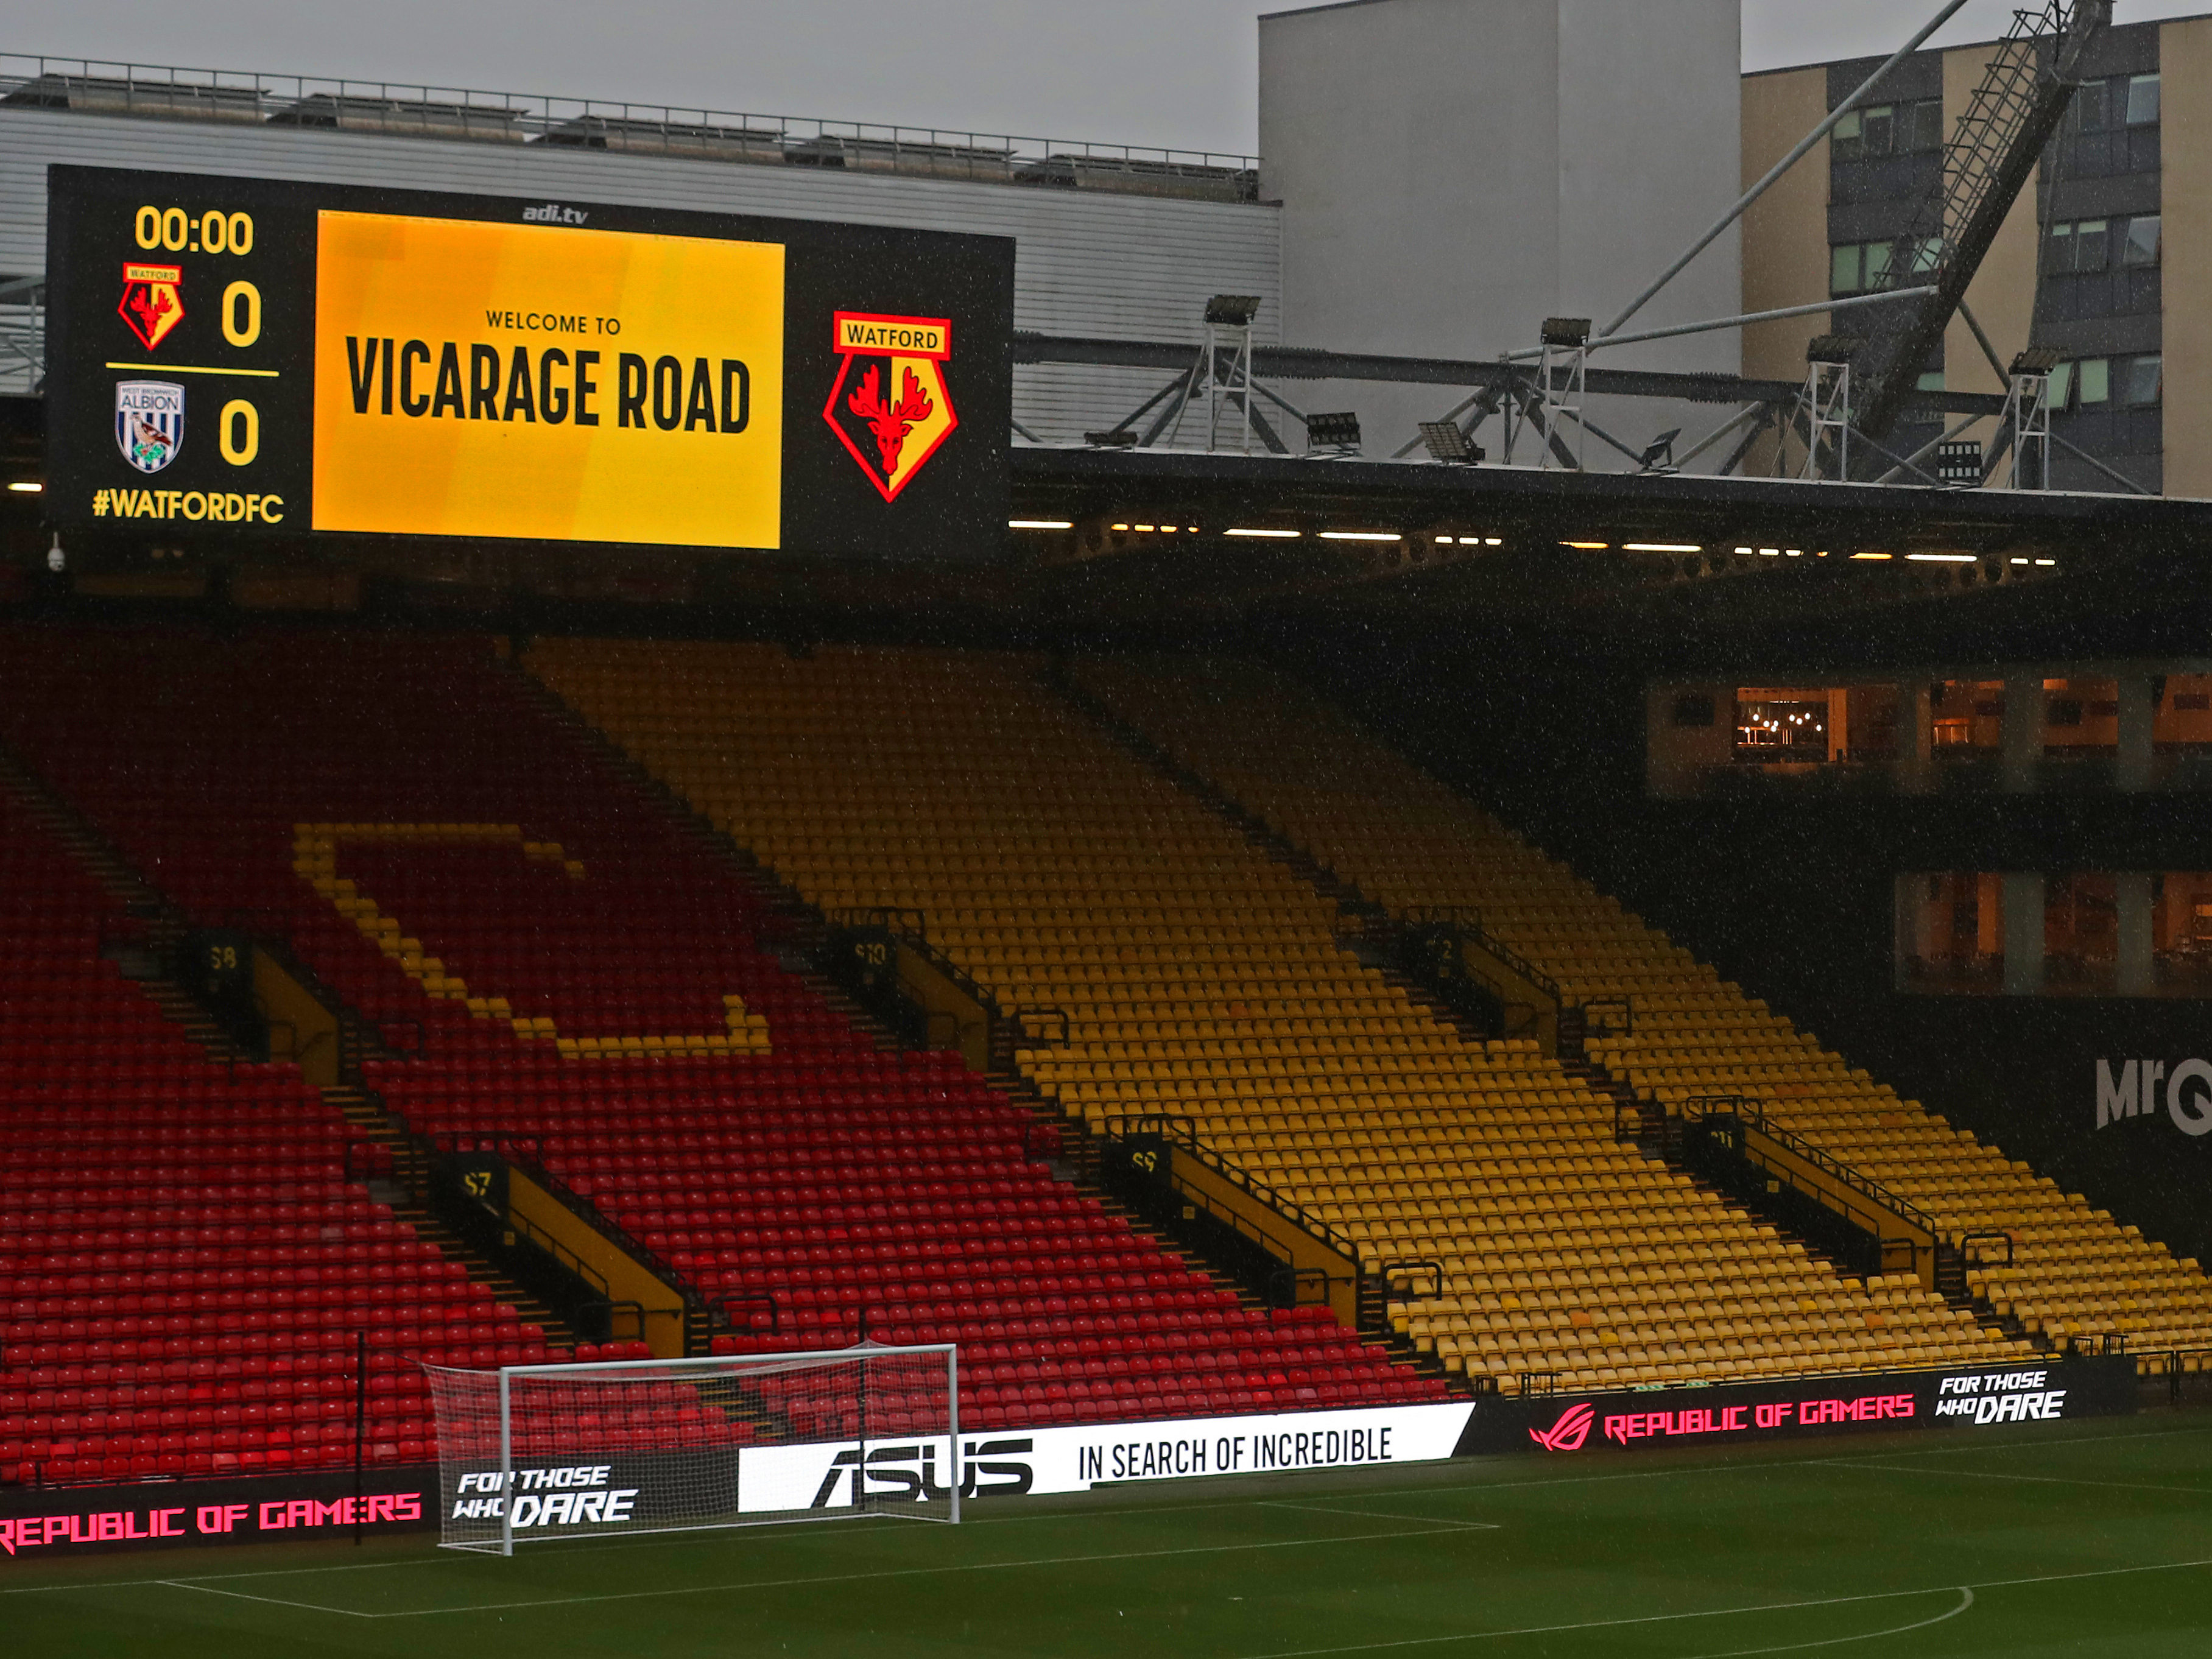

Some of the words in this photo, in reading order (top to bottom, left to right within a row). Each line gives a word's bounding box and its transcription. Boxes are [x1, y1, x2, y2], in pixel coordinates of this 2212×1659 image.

[135, 205, 254, 256] 00:00
[523, 204, 588, 225] adi.tv
[130, 269, 176, 280] WATFORD
[222, 280, 261, 347] 0
[486, 311, 586, 333] WELCOME
[596, 318, 620, 335] TO
[847, 324, 939, 350] WATFORD
[121, 395, 178, 410] ALBION
[345, 336, 600, 426] VICARAGE
[618, 352, 750, 434] ROAD
[219, 399, 259, 466] 0
[93, 488, 284, 524] #WATFORDFC
[211, 946, 236, 970] S8
[2096, 1058, 2212, 1136] MrQ
[464, 1172, 491, 1196] S7
[1939, 1376, 1981, 1395] FOR
[1984, 1371, 2048, 1391] THOSE
[1604, 1406, 1748, 1445] REPUBLIC
[1755, 1403, 1792, 1428] OF
[1800, 1393, 1914, 1425] GAMERS
[1935, 1398, 1978, 1416] WHO
[1974, 1390, 2067, 1425] DARE
[1079, 1445, 1103, 1481] IN
[1111, 1438, 1206, 1478] SEARCH
[1217, 1435, 1245, 1471] OF
[1253, 1427, 1392, 1468] INCREDIBLE
[520, 1465, 611, 1490] THOSE
[811, 1438, 1033, 1508] ASUS
[0, 1507, 185, 1555] REPUBLIC
[196, 1503, 248, 1534] OF
[259, 1493, 421, 1530] GAMERS
[509, 1489, 639, 1529] DARE
